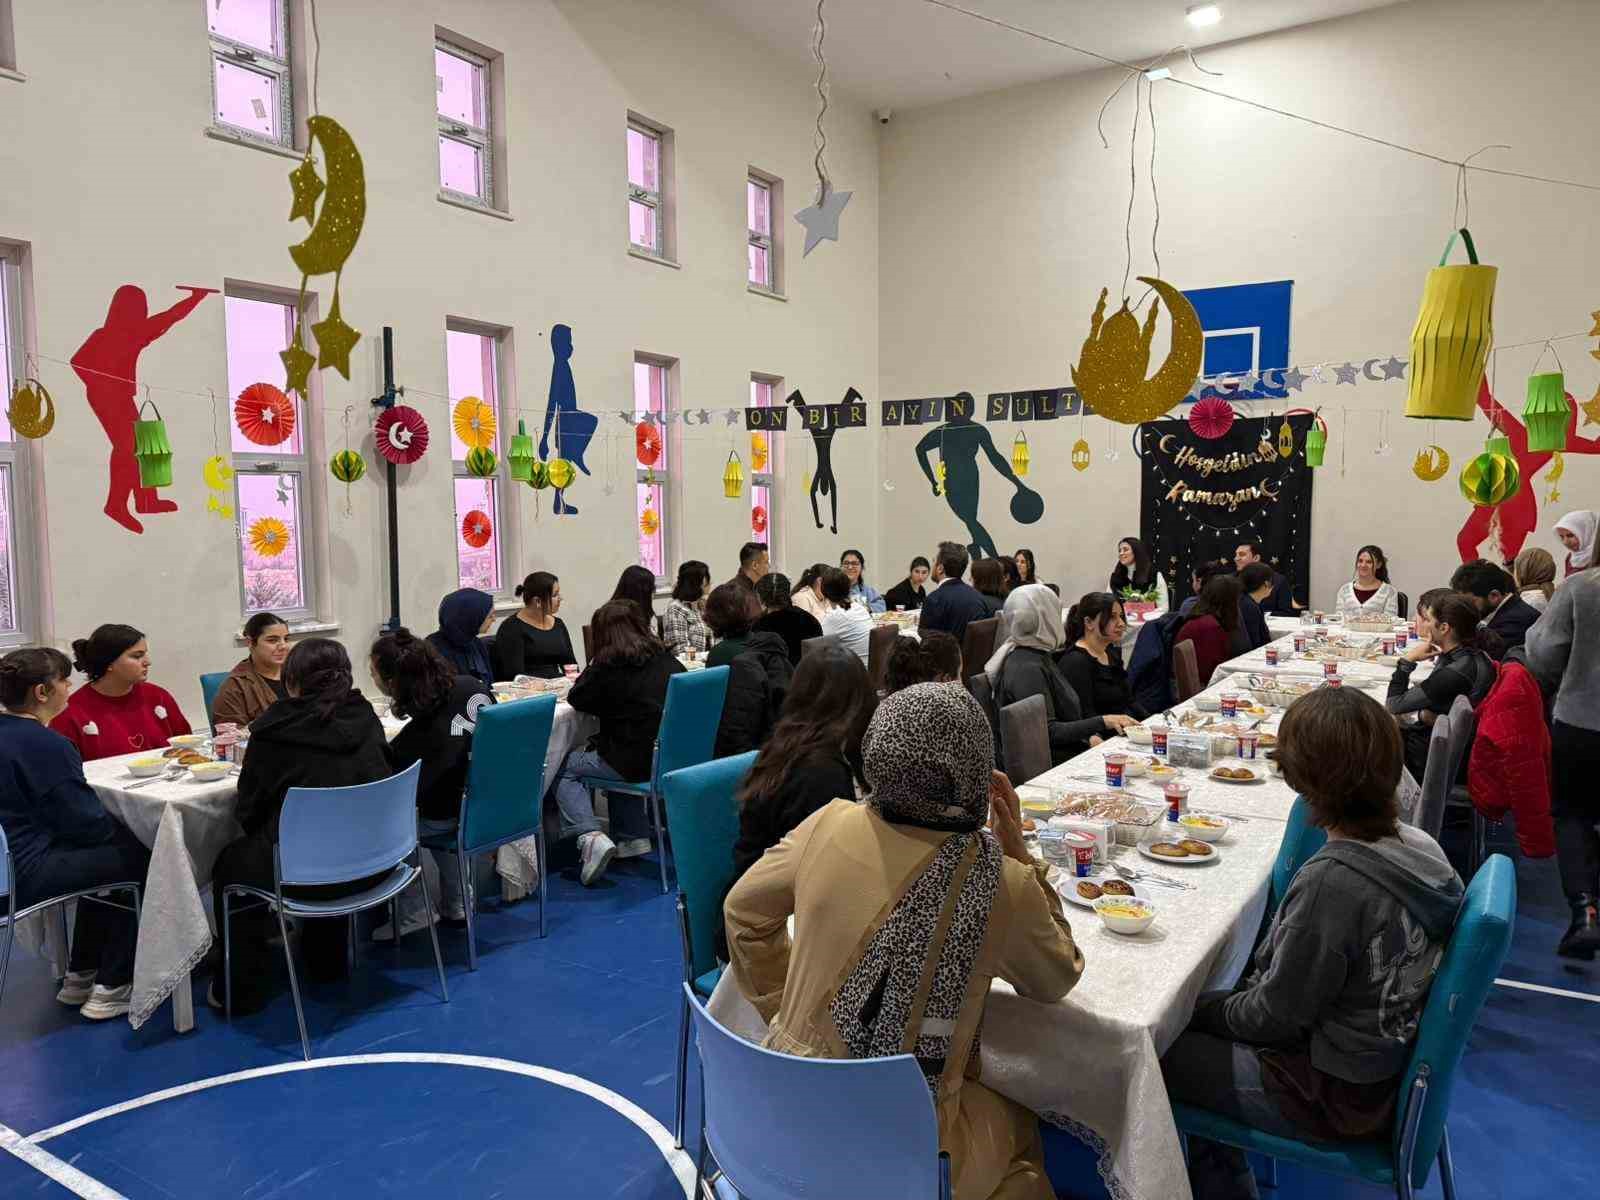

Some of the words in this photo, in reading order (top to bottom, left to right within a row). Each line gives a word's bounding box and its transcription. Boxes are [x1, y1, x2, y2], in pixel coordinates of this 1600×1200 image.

[751, 409, 784, 426] ON
[809, 406, 863, 426] BİR
[886, 399, 966, 421] AYIN
[992, 393, 1077, 416] SULT
[1165, 480, 1261, 513] Ramazan
